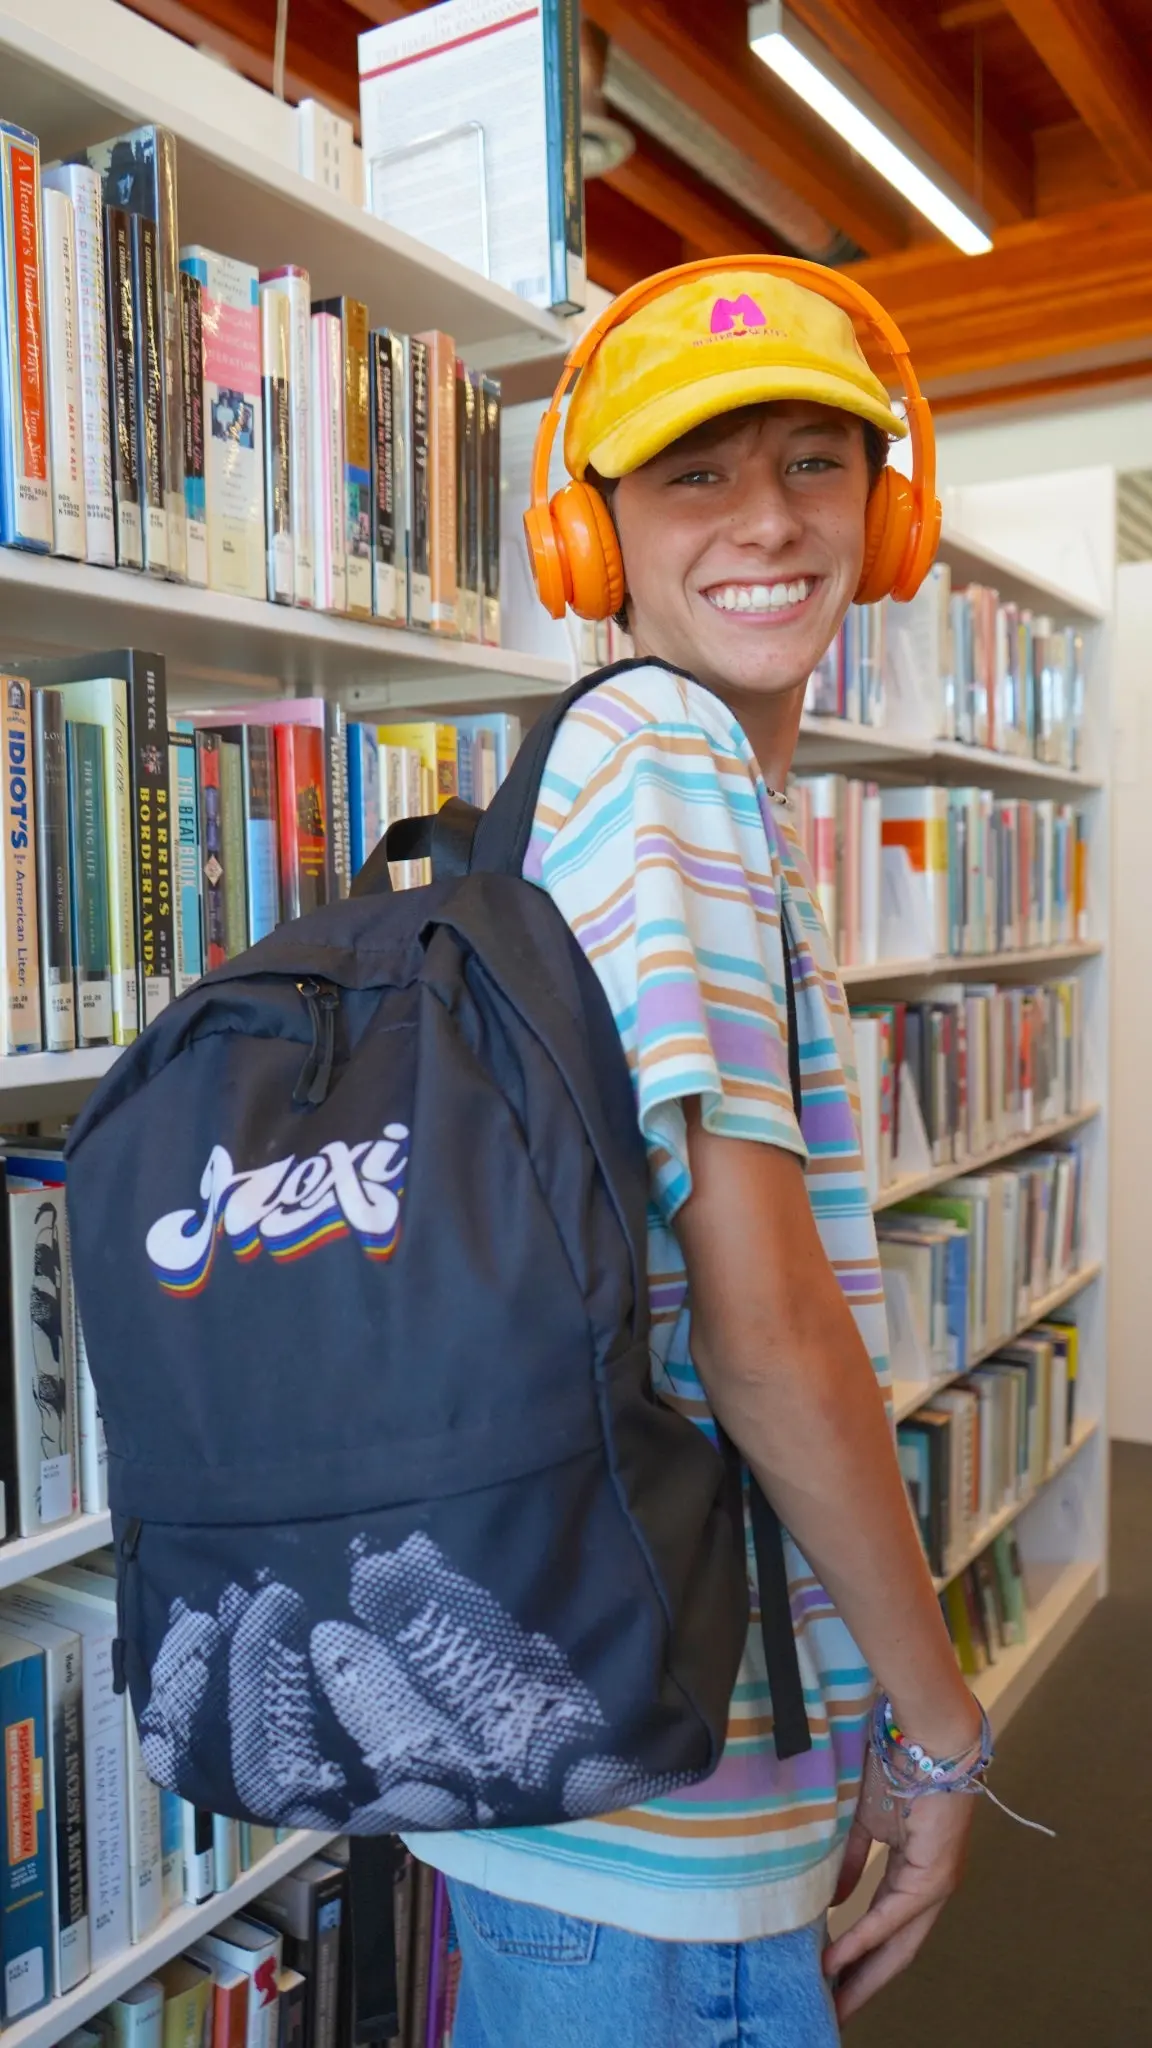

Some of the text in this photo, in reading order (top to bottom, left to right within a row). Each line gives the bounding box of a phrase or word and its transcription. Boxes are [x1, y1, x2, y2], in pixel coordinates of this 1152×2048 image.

[18, 156, 33, 171] A
[20, 180, 35, 257] Reader's
[23, 263, 37, 312] Book
[26, 343, 41, 385] Days
[116, 347, 124, 381] SLAVE
[128, 376, 136, 420] AFRICAN
[148, 368, 158, 419] HARLEM
[29, 409, 41, 437] Tom
[130, 422, 138, 480] AMERICAN
[150, 423, 160, 504] RENAISSANCE
[145, 670, 157, 731] HEYCK
[8, 729, 28, 850] IDIOT'S
[83, 759, 93, 784] THE
[330, 736, 342, 806] FLAPPERS
[84, 788, 95, 846] WRITING
[177, 777, 196, 888] THE BEAT BOOK
[86, 849, 96, 881] LIFE
[156, 788, 170, 917] BARRIOS
[333, 822, 344, 876] SWELLS
[15, 869, 27, 942] American
[139, 786, 155, 977] BORDERLANDS
[65, 1752, 81, 1832] INCEST,
